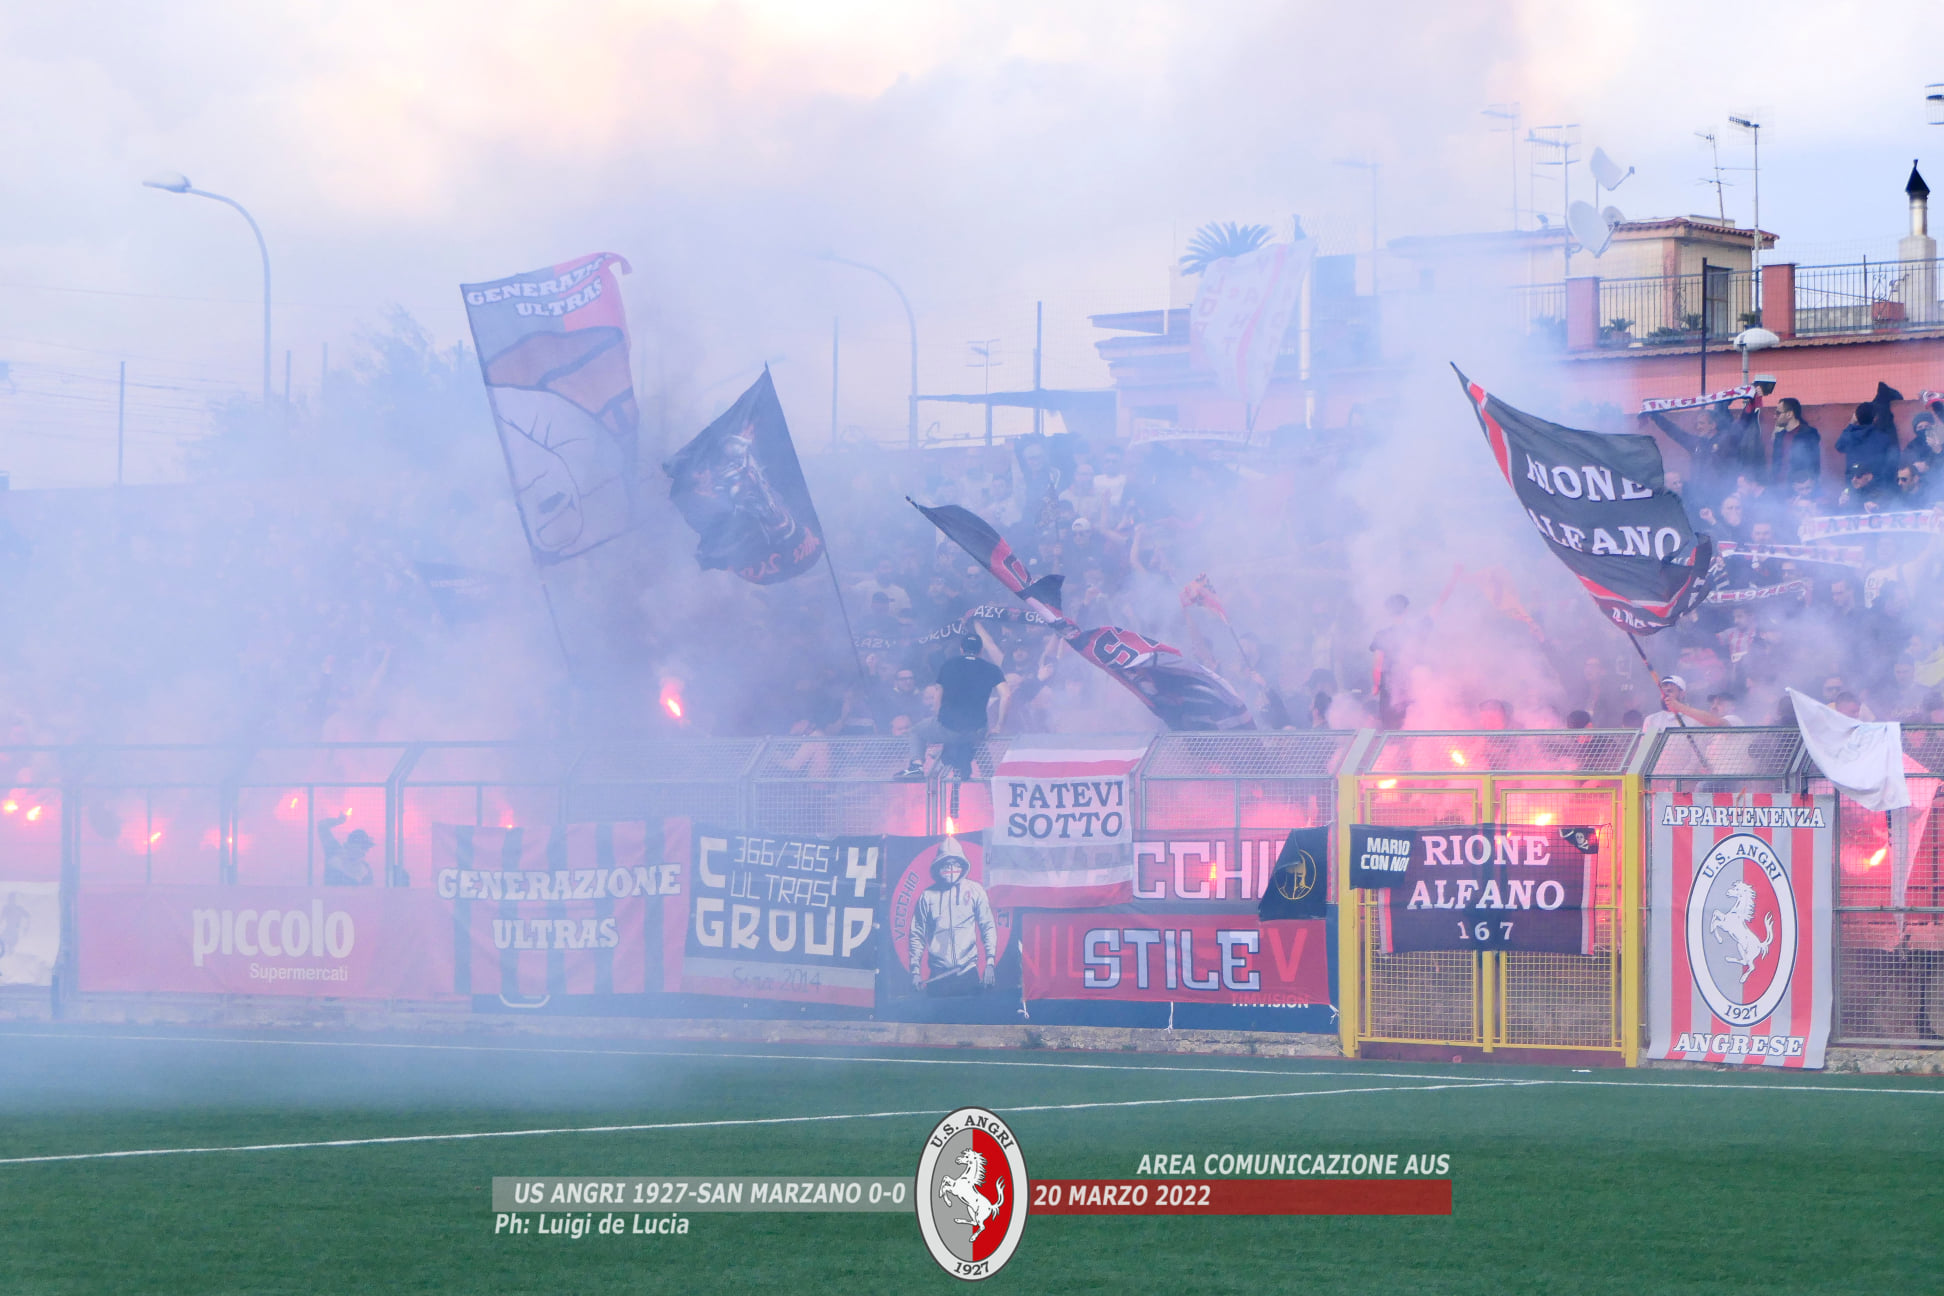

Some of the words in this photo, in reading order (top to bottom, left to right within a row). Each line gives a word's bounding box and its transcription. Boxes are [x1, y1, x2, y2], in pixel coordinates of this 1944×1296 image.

[515, 277, 603, 316] ULTRAS
[974, 604, 1005, 618] AZY
[1008, 781, 1124, 809] FATEVI
[1008, 811, 1123, 839] SOTTO
[1662, 806, 1825, 828] APPARTENENZA
[733, 836, 831, 873] 366/365
[1367, 837, 1410, 856] MARIO
[1422, 835, 1550, 866] RIONE
[1736, 843, 1782, 880] ANGRI
[1361, 854, 1389, 871] CON
[1390, 856, 1410, 872] NOI
[437, 863, 681, 900] GENERAZIONE
[730, 870, 831, 908] ULTRAS
[1407, 880, 1565, 911] ALFANO
[193, 899, 355, 967] piccolo
[492, 918, 619, 950] ULTRAS
[696, 897, 874, 957] GROUP
[249, 963, 348, 983] Supermercati
[1083, 928, 1261, 991] STILE
[1724, 1004, 1758, 1020] 1927
[1673, 1032, 1804, 1056] ANGRESE
